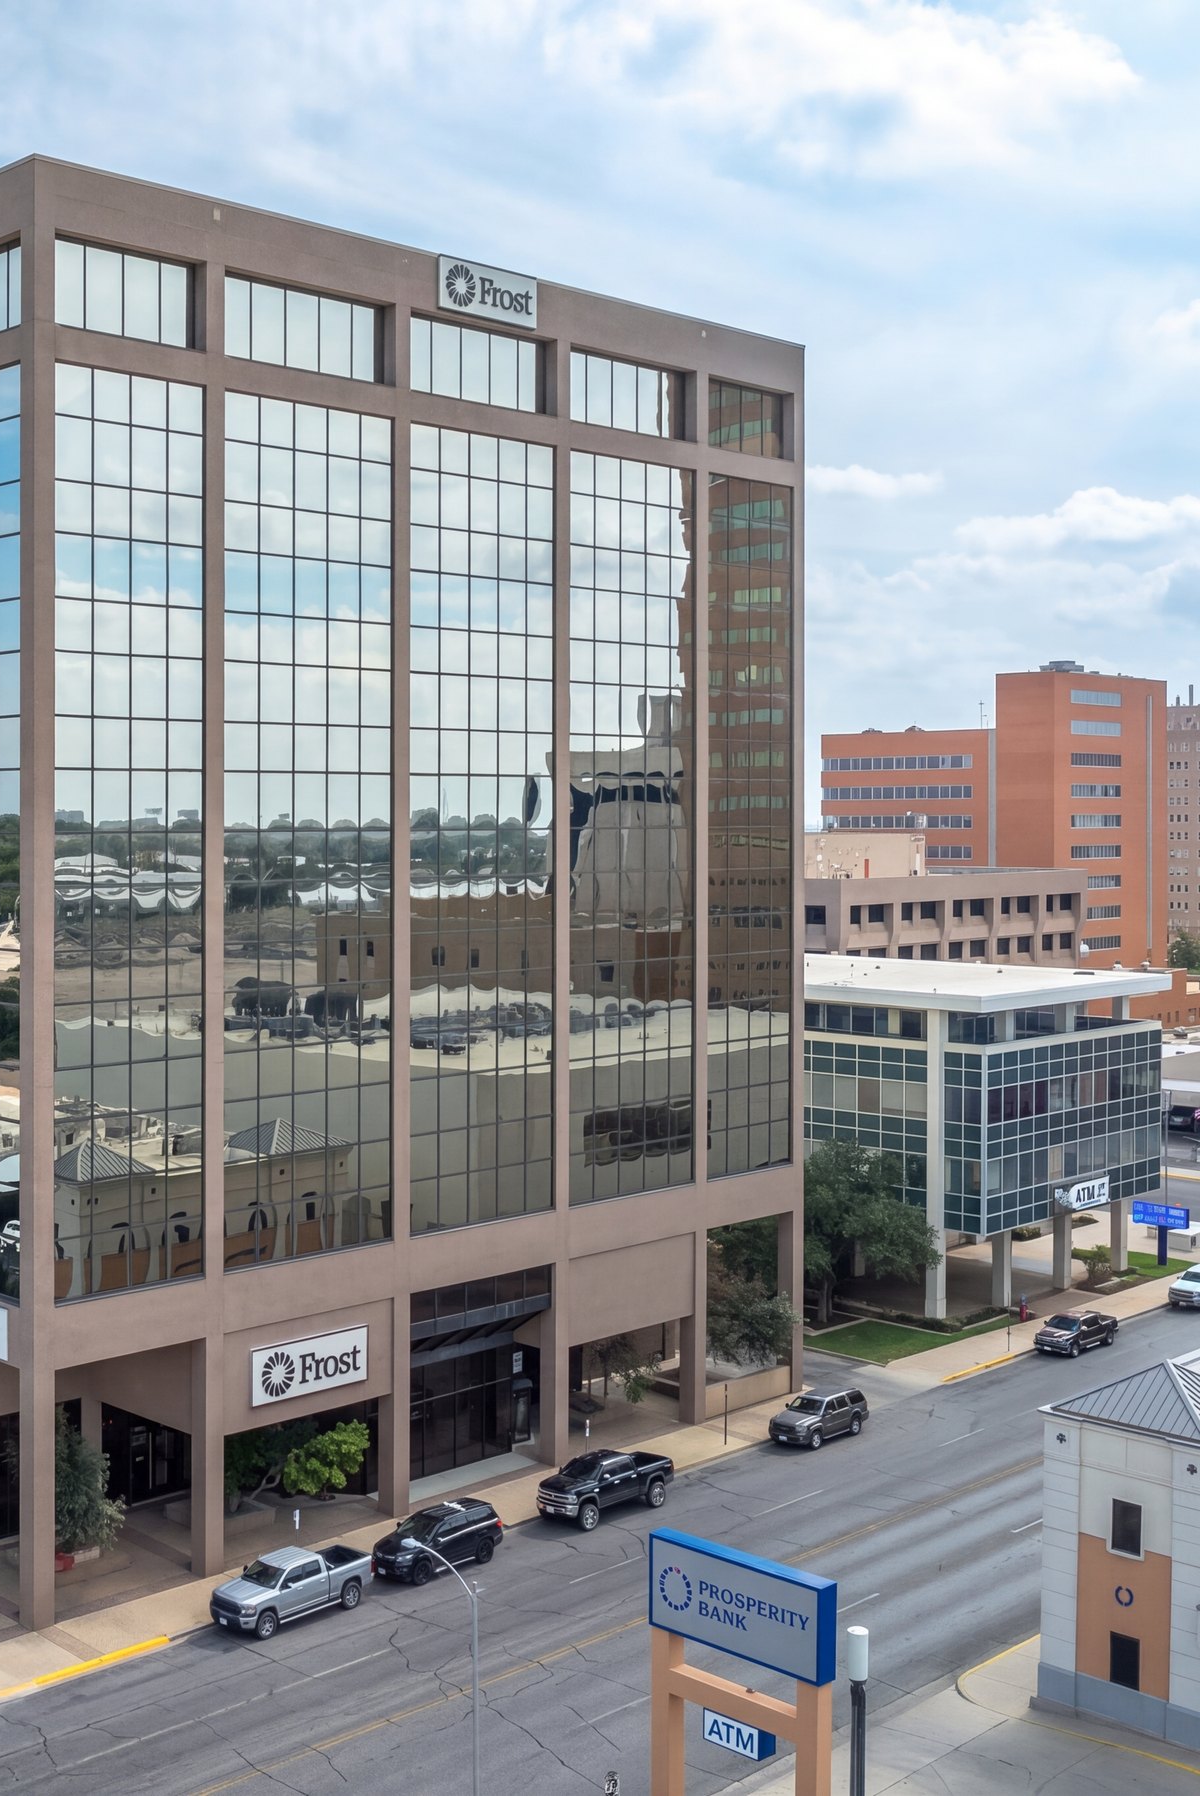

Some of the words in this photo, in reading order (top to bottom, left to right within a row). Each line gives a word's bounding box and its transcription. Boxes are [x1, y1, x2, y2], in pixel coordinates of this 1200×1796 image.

[478, 276, 533, 316] Frost
[1075, 1185, 1095, 1203] ATM
[298, 1344, 361, 1384] Frost
[698, 1580, 810, 1632] PROSPERITY
[698, 1600, 748, 1632] BANK
[708, 1718, 754, 1754] ATM
